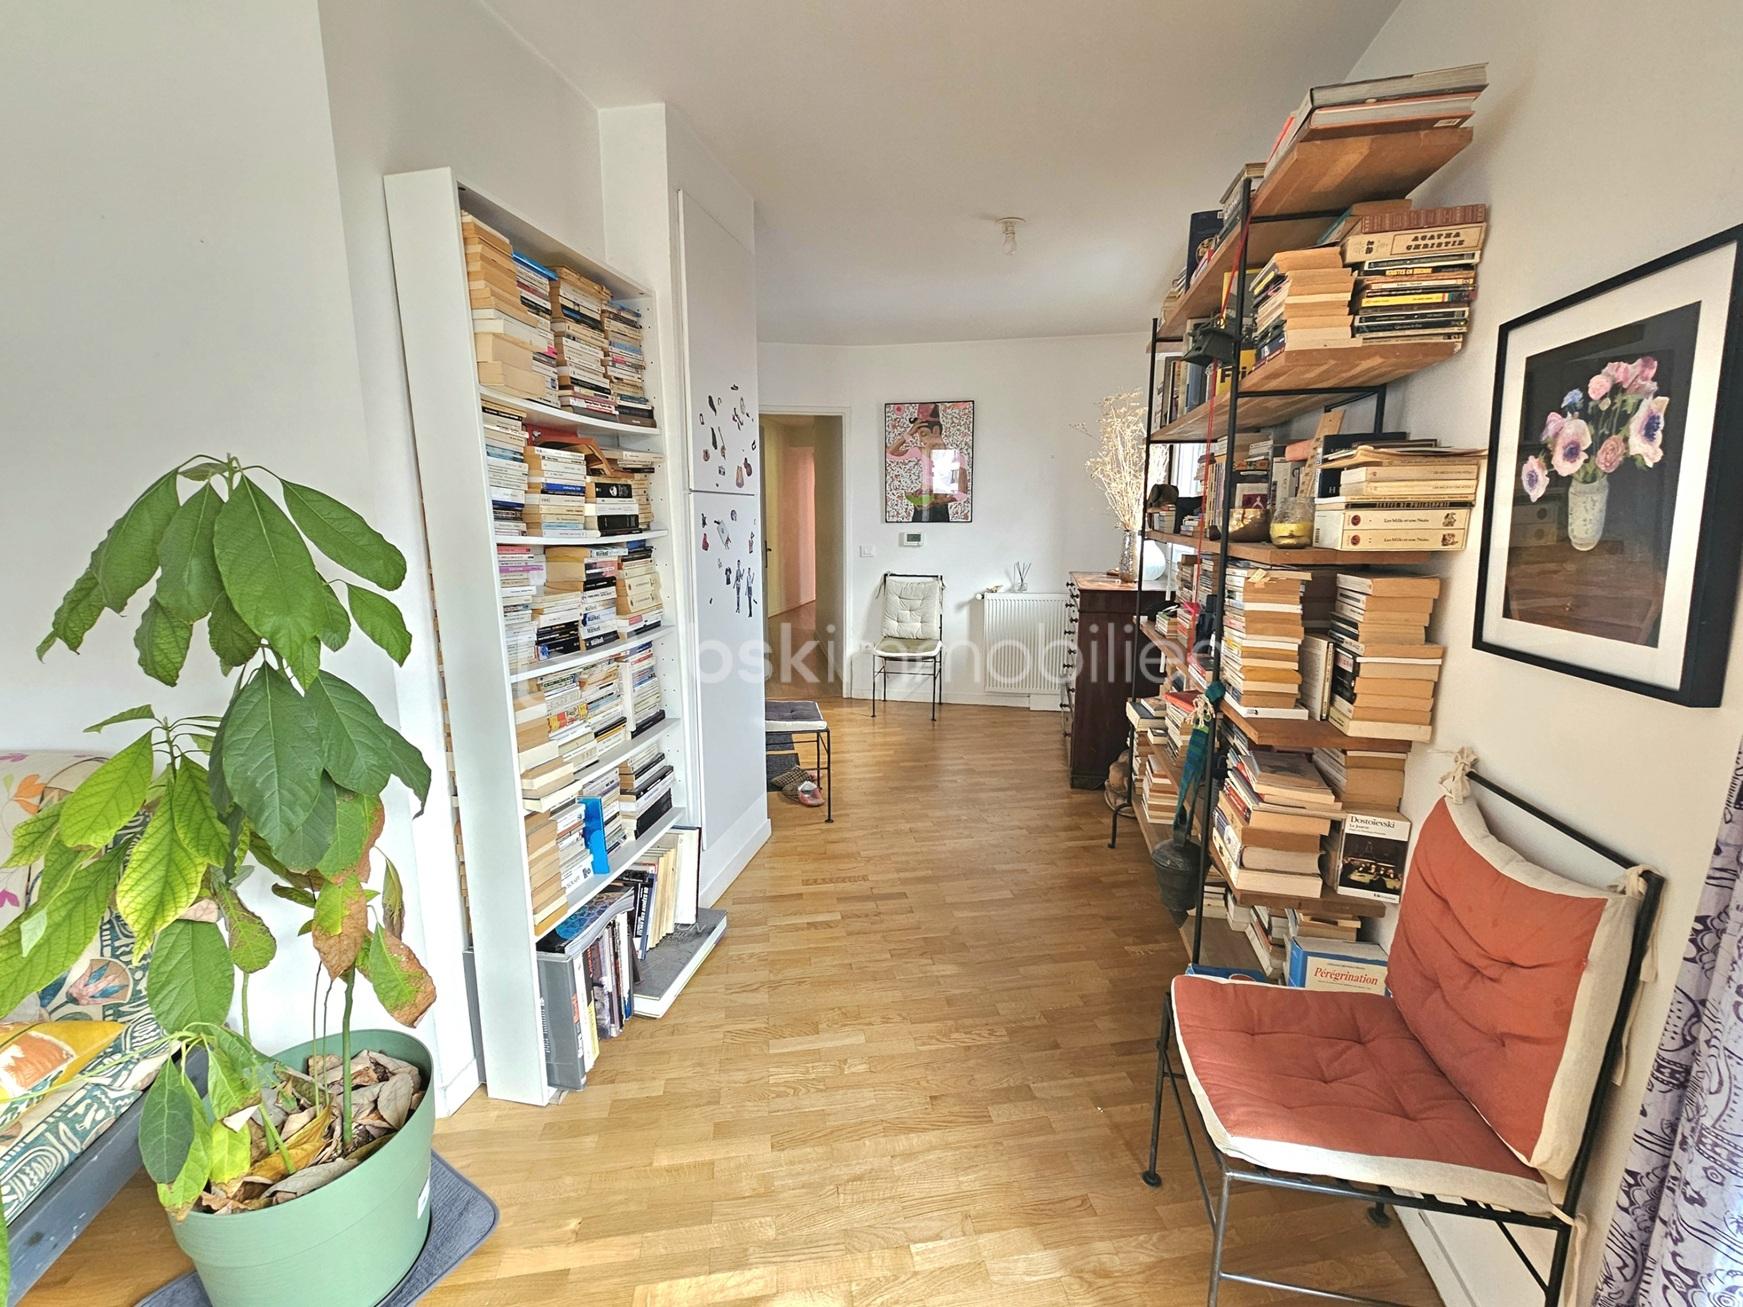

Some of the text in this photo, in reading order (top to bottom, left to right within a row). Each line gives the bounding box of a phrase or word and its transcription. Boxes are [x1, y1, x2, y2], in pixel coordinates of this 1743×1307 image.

[1411, 231, 1461, 242] AGATHA
[1406, 239, 1465, 251] CHRISTIE
[1350, 815, 1396, 829] Dostoïevski
[1314, 967, 1378, 986] Pérégrination
